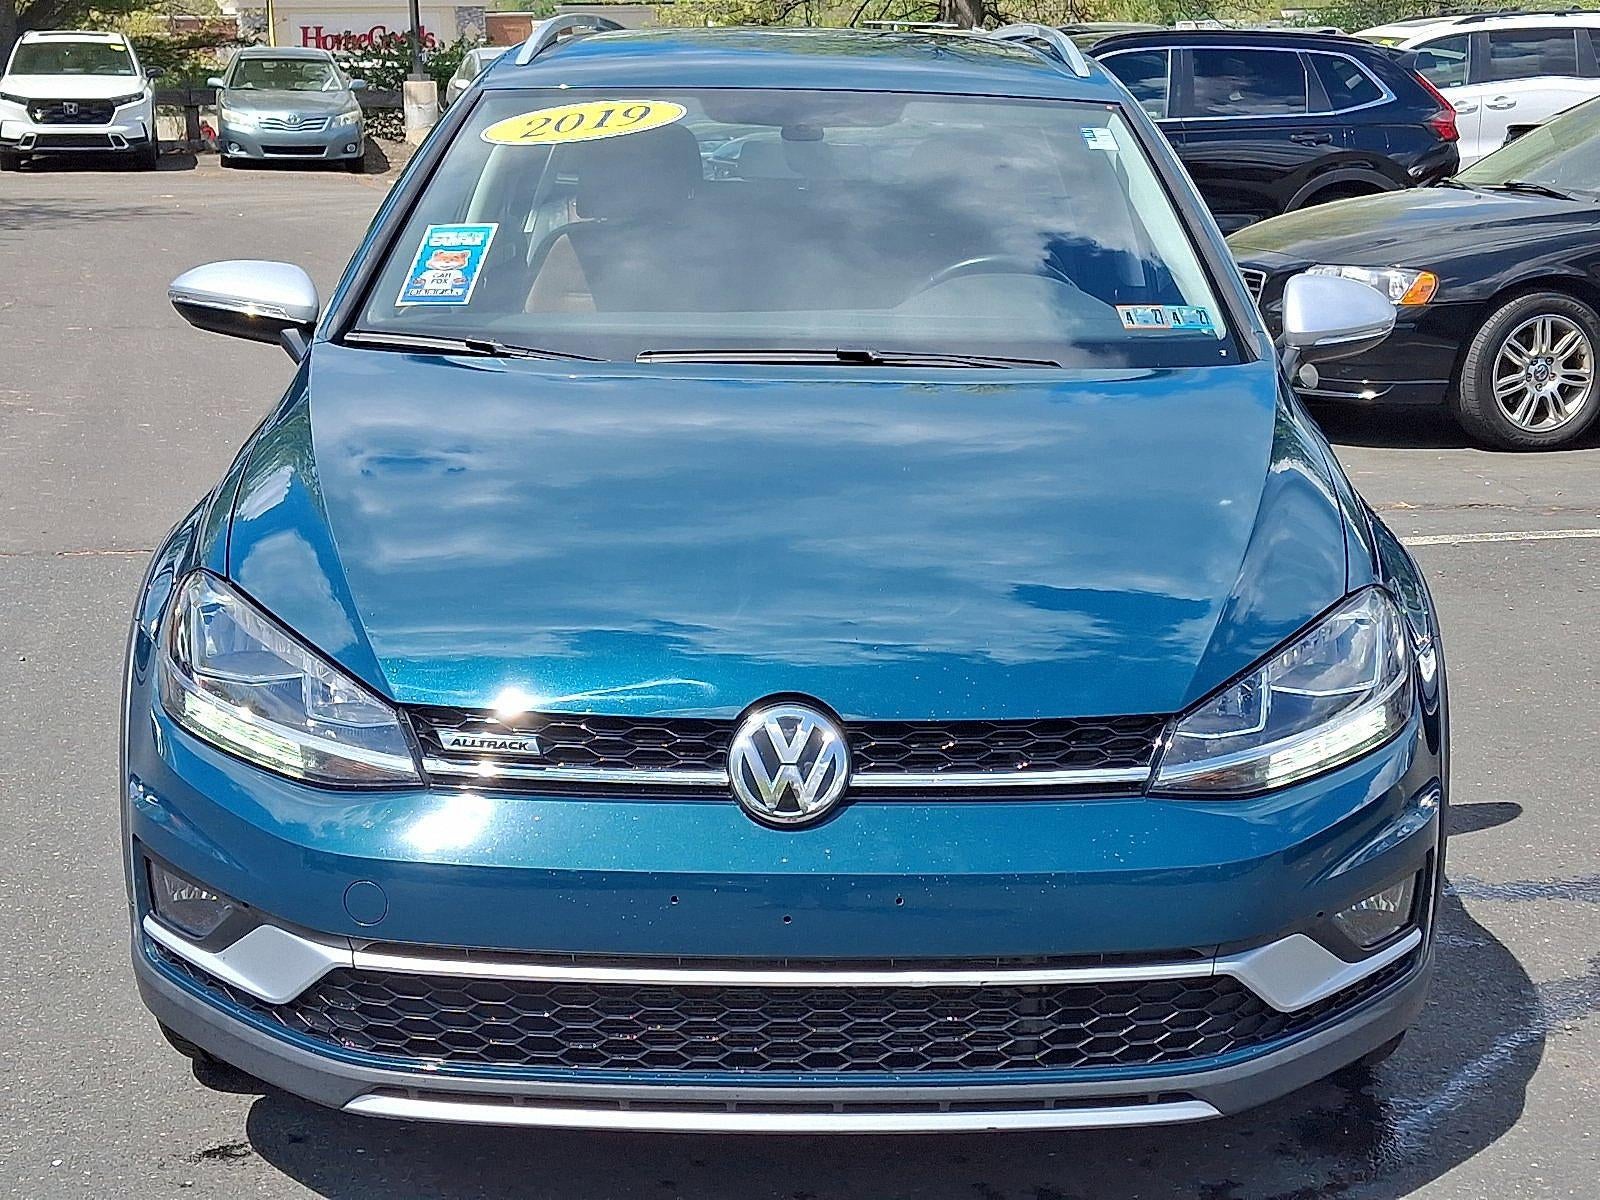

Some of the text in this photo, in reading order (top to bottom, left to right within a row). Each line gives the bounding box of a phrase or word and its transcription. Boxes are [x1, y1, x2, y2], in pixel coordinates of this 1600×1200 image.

[300, 25, 436, 51] HomeGs
[519, 105, 651, 139] 2019
[450, 738, 530, 751] ALLTRACK
